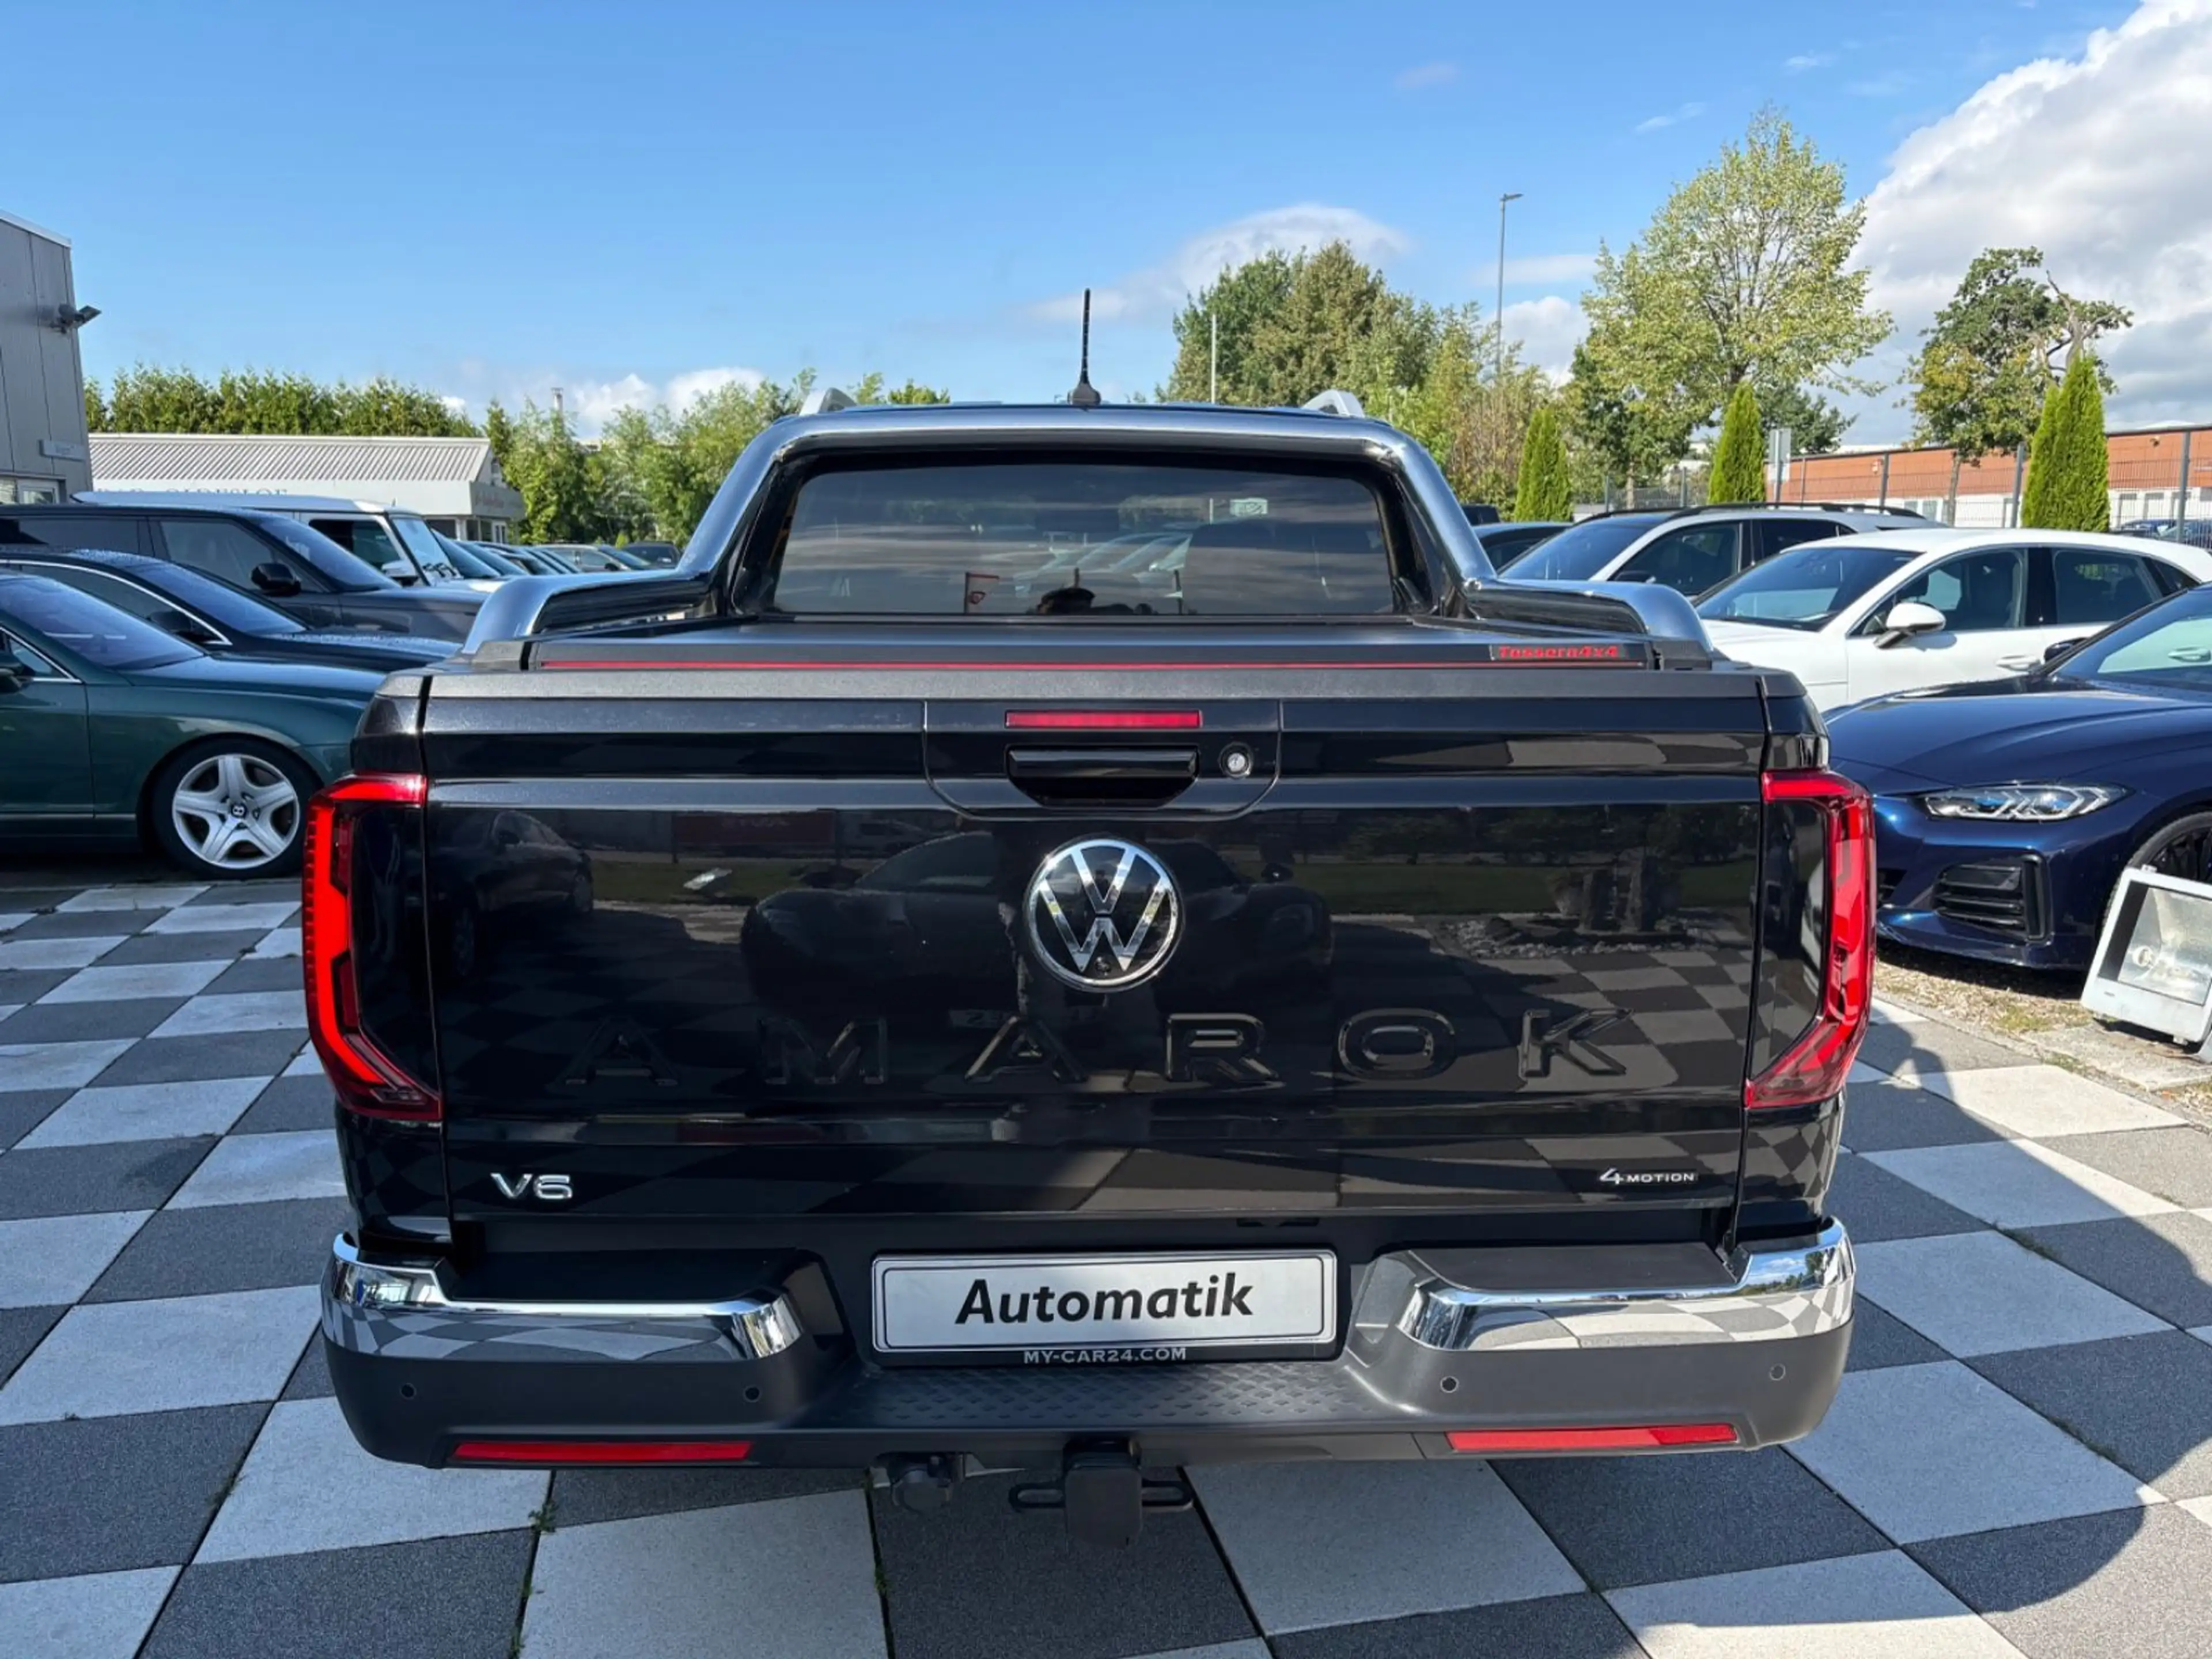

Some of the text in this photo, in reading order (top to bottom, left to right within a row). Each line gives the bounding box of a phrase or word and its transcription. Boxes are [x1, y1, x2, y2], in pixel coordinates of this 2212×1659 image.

[565, 1007, 1634, 1086] AMAROK
[490, 1172, 573, 1199] V6
[1599, 1168, 1696, 1185] 4MOTION
[955, 1272, 1253, 1324] Automatik
[1023, 1347, 1187, 1364] MY-CAR24.COM
